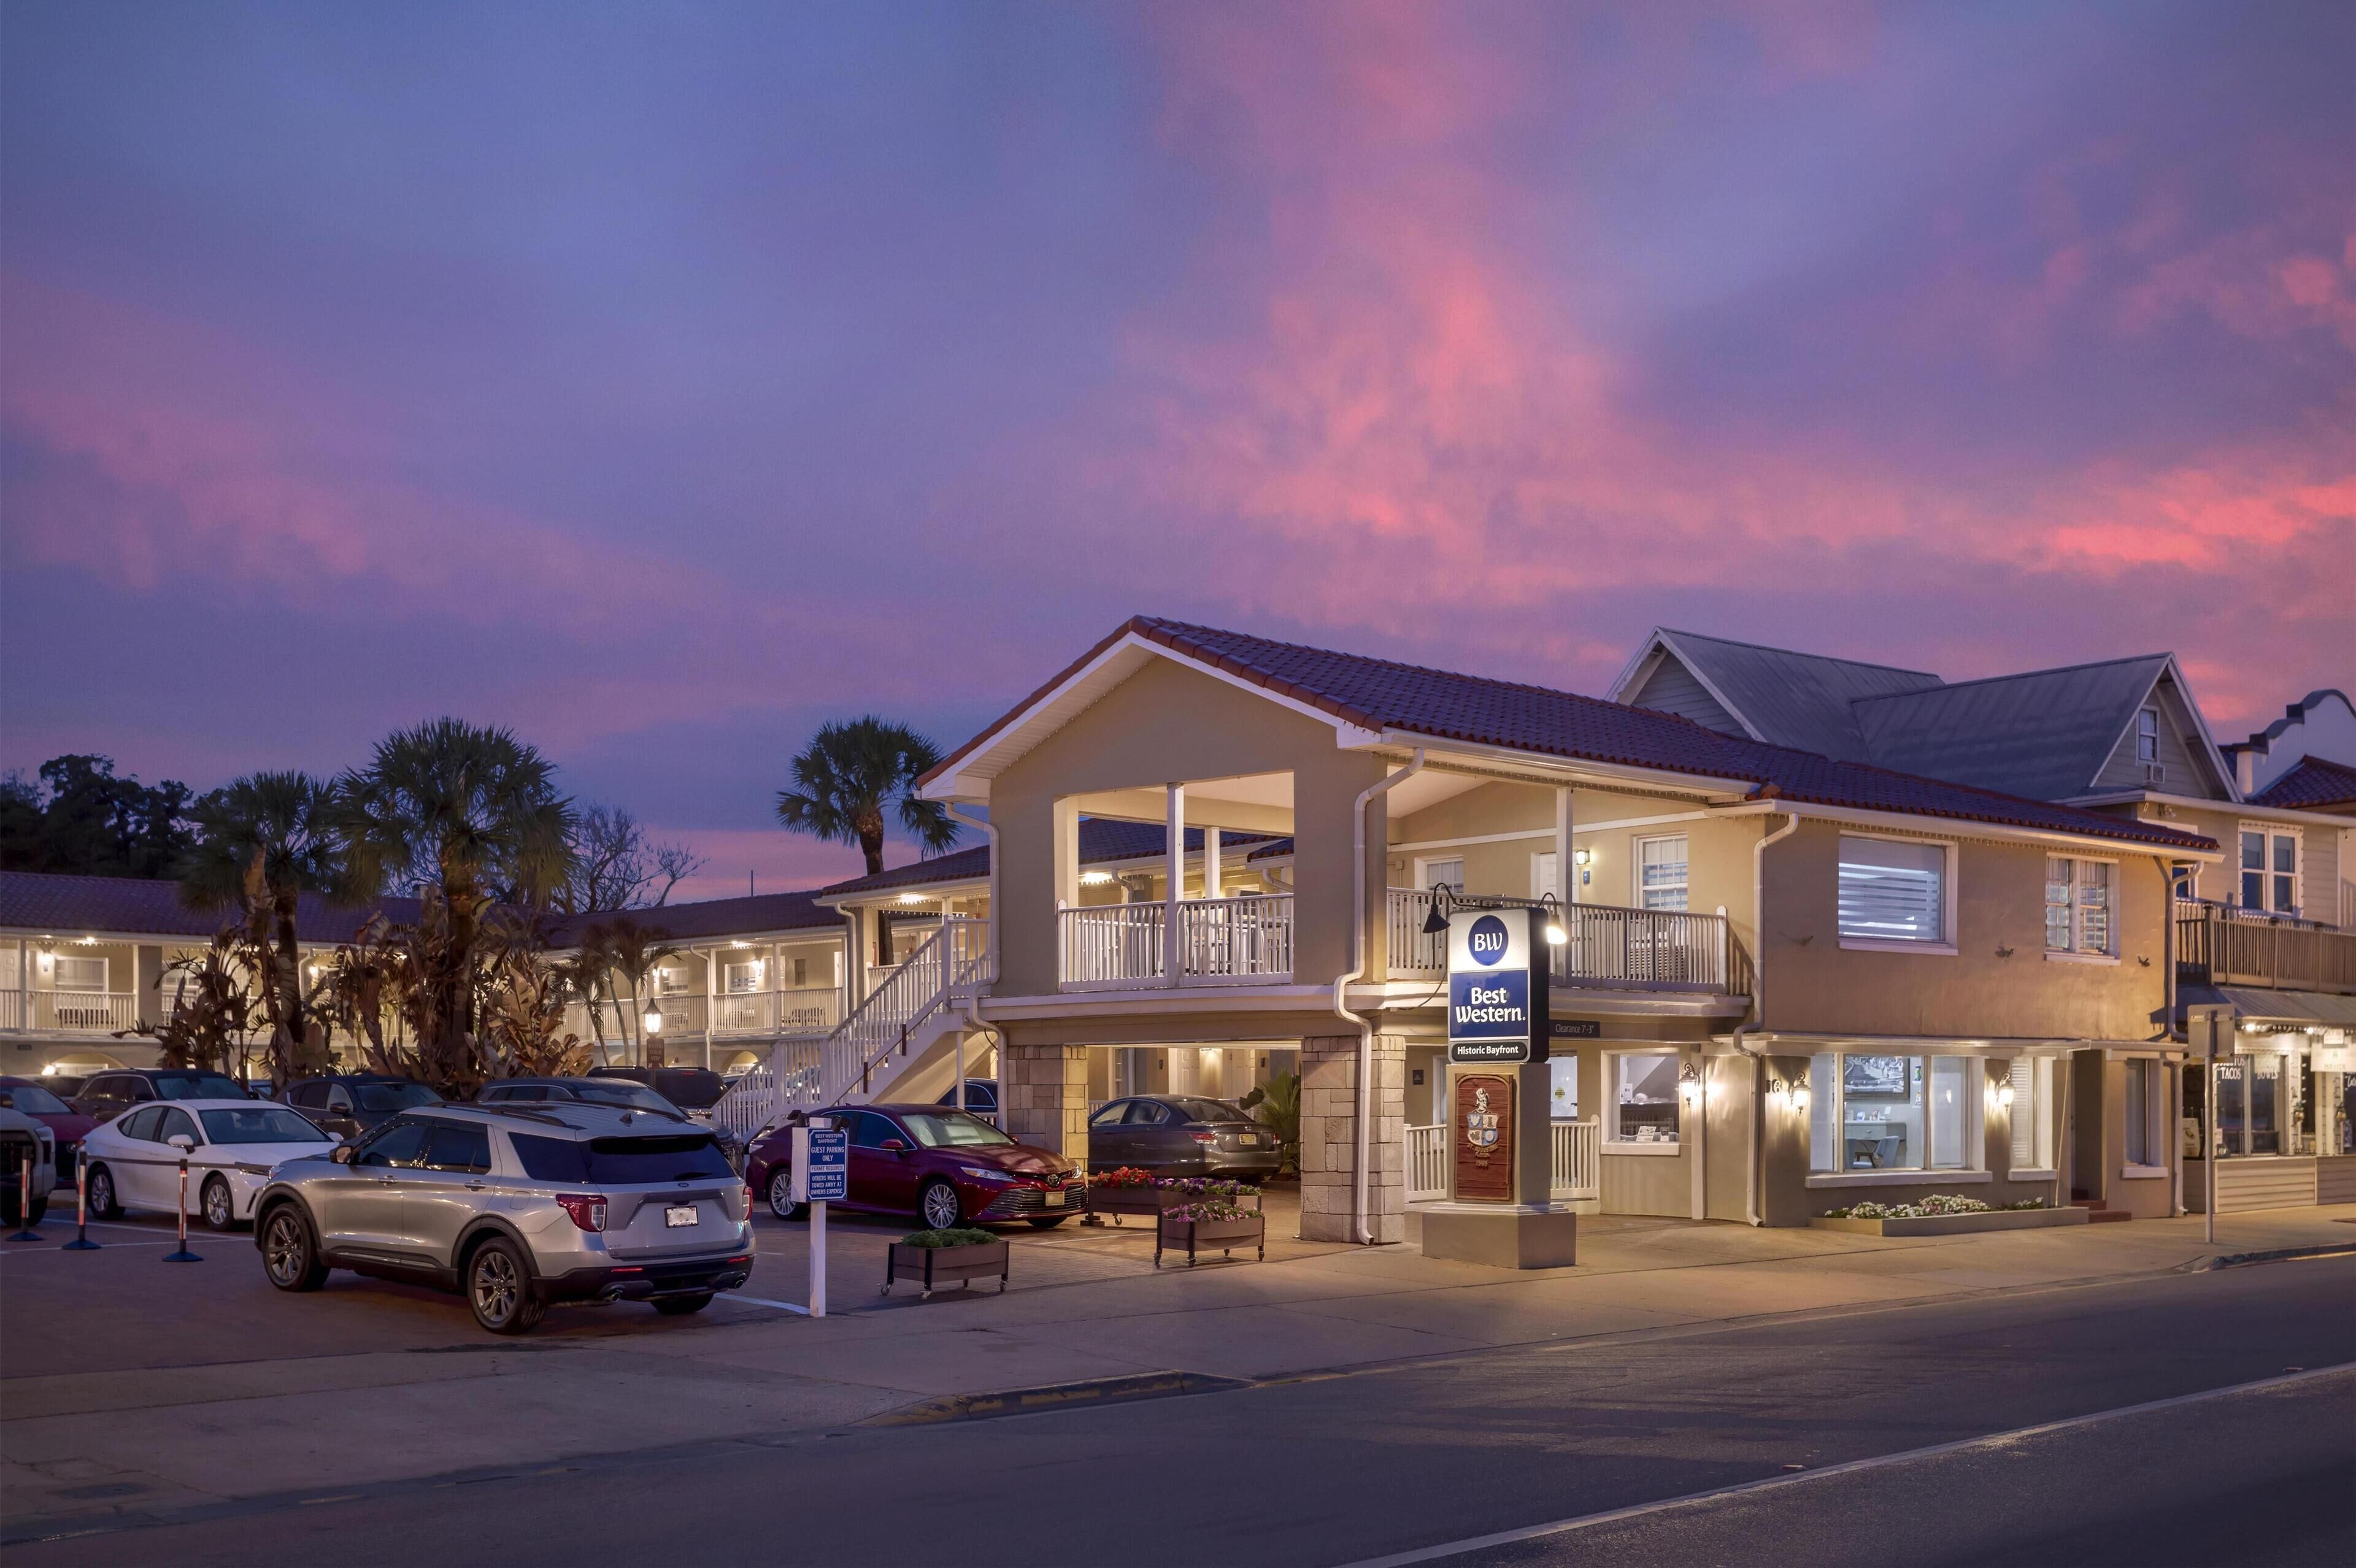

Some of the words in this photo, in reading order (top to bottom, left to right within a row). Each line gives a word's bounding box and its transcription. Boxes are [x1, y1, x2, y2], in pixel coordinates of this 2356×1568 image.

[1474, 932, 1503, 951] BW
[1471, 986, 1507, 1005] Best
[1555, 1024, 1580, 1033] Clearance
[1457, 1045, 1485, 1055] Historic
[1486, 1045, 1519, 1056] Bayfront
[2221, 1067, 2241, 1080] TACOS
